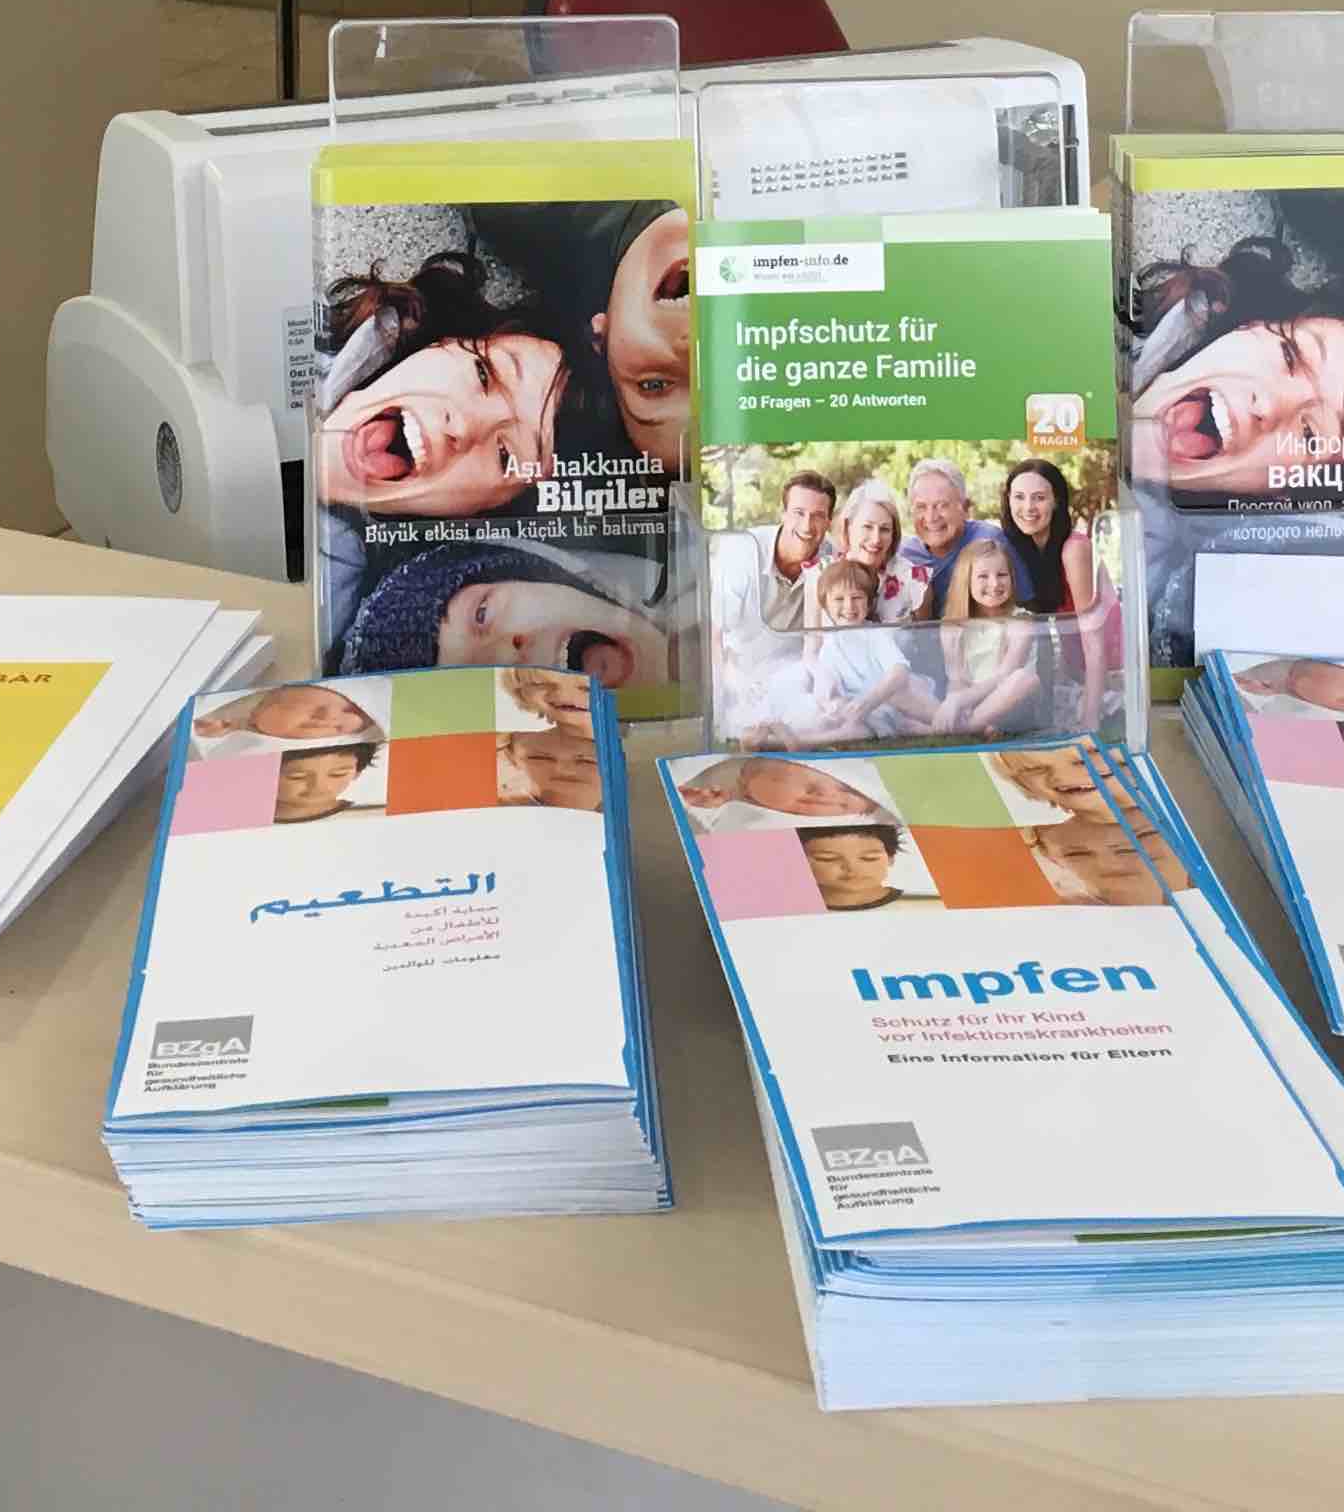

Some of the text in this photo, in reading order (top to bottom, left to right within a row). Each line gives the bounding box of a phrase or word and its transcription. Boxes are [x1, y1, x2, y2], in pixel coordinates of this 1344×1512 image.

[752, 254, 849, 269] impfen-info.de
[735, 316, 938, 350] Impfschutz für
[735, 352, 977, 387] die ganze Familie
[738, 396, 757, 410] 20
[760, 395, 811, 411] Fragen
[829, 394, 849, 408] 20
[852, 393, 927, 407] Antworten
[1033, 398, 1079, 433] 20
[1032, 435, 1079, 447] FRAGEN
[503, 450, 665, 484] Aşı hakkında
[536, 478, 665, 516] Bilgiler
[364, 515, 665, 546] Büyük etkisi olan küçük bir batırma
[1233, 524, 1301, 542] которого
[249, 871, 497, 924] التطعيم
[849, 959, 1158, 1005] Impfen
[871, 1010, 1086, 1029] Schutz für Ihr Kind
[878, 1022, 1174, 1044] vor Infektionskrankheiten
[157, 1037, 247, 1058] BZgA
[887, 1047, 1173, 1064] Eine Information für Eltern
[824, 1144, 926, 1170] BZgA
[825, 1168, 934, 1184] Bundeszentrale
[833, 1184, 942, 1202] gesundheitliche
[836, 1197, 914, 1210] Aufklärung
